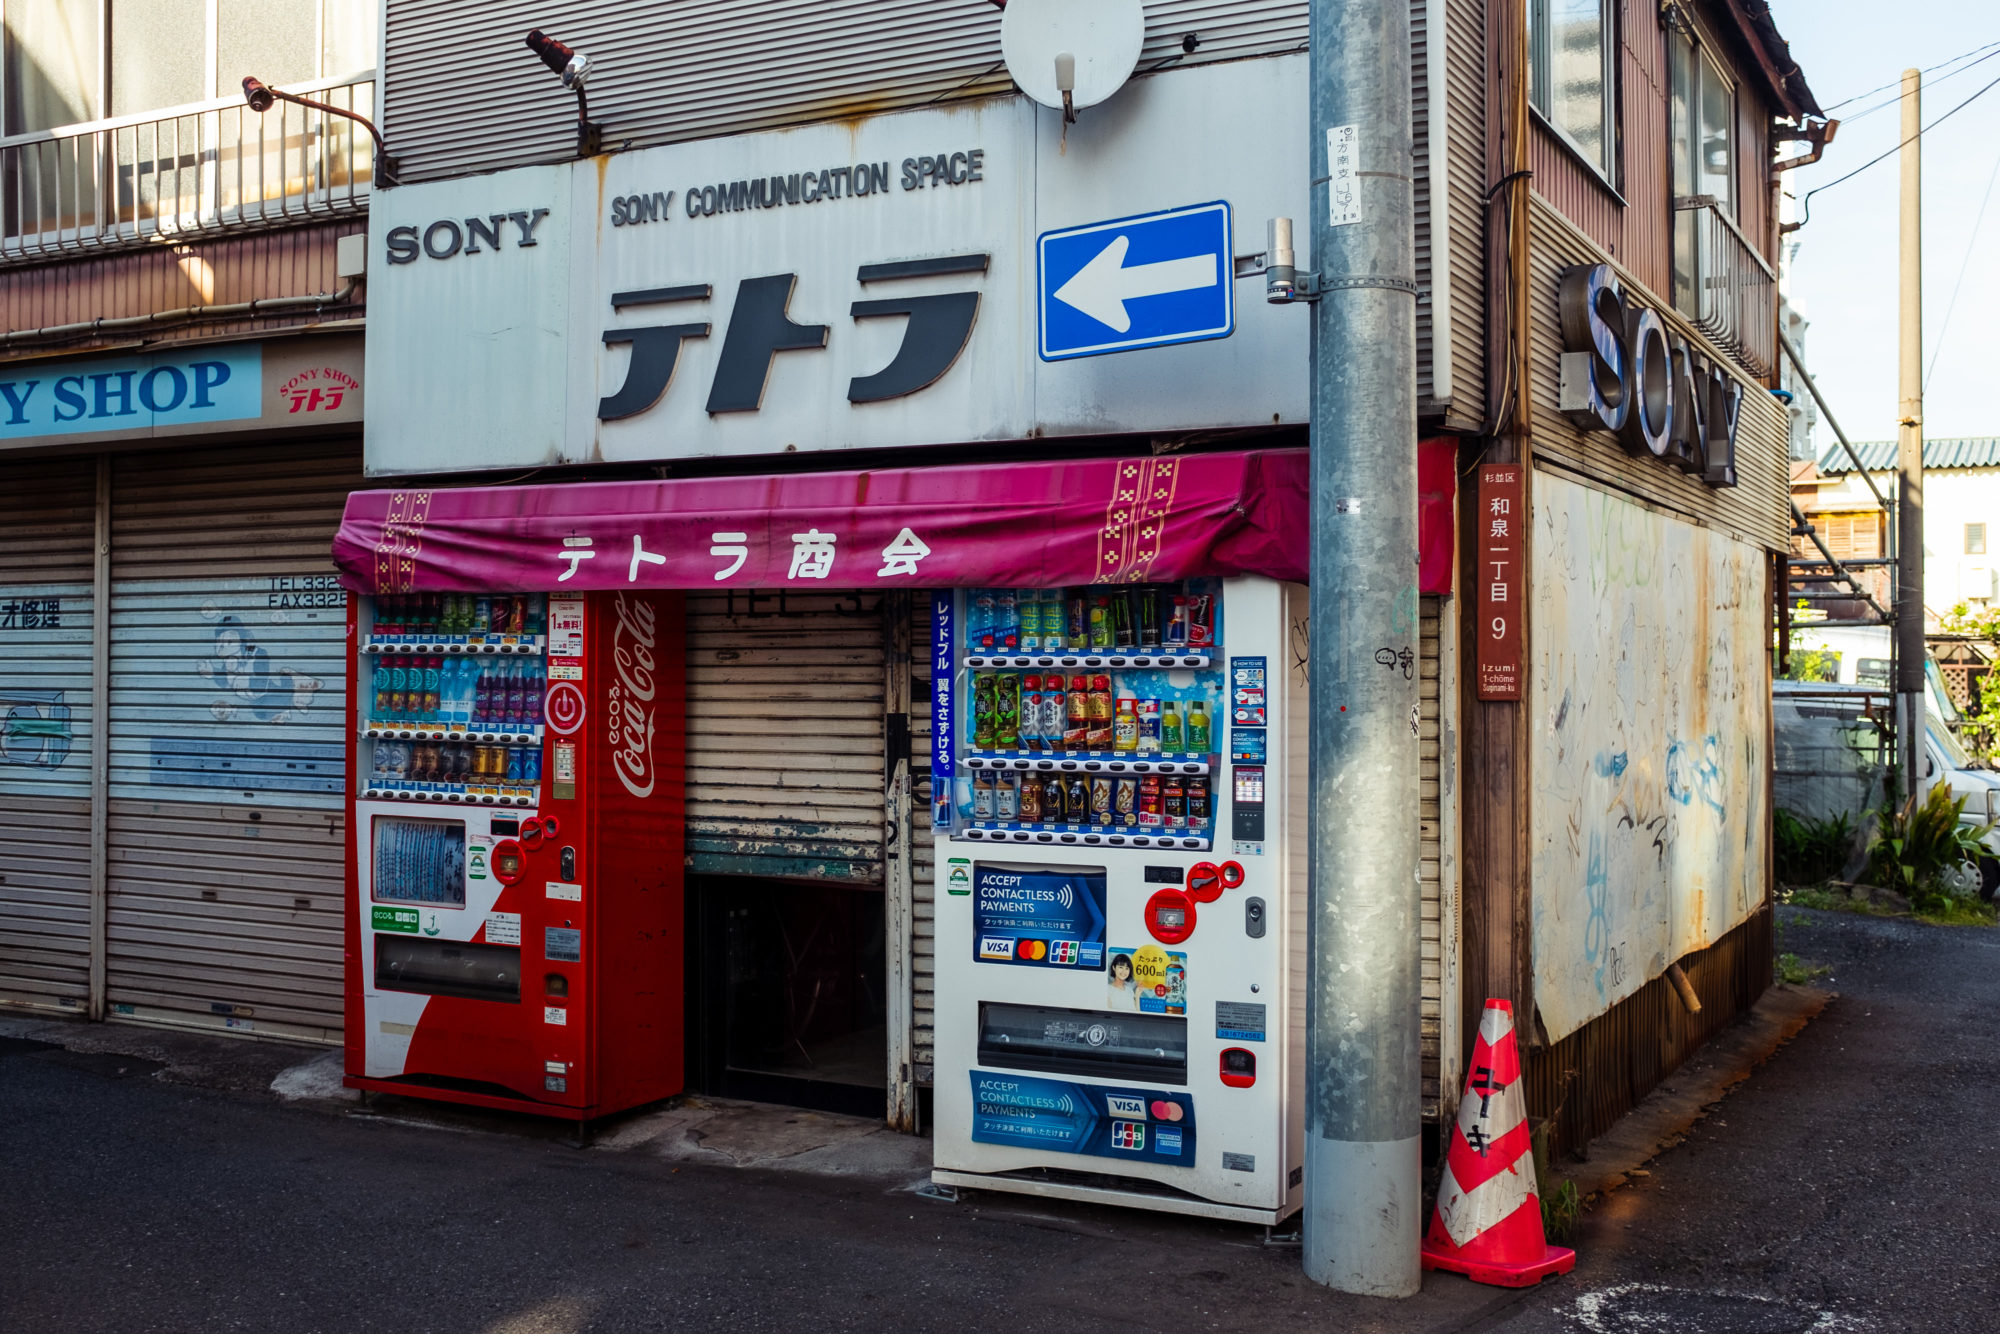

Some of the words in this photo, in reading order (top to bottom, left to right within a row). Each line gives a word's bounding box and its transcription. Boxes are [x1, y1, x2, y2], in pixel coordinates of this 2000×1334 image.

[611, 191, 675, 226] SONY
[686, 161, 889, 217] COMMUNICATION
[901, 149, 985, 191] SPACE
[386, 208, 550, 265] SONY
[598, 254, 991, 422] テトラ
[280, 368, 318, 398] SONY
[323, 367, 359, 392] SHOP
[1559, 263, 1744, 489] SONY
[53, 360, 231, 423] SHOP
[289, 386, 346, 414] テトラ
[1484, 472, 1516, 483] 杉並区
[557, 527, 932, 582] テトラ商会
[1489, 497, 1510, 602] 和泉一丁目
[937, 601, 950, 670] レッドブル
[1491, 617, 1506, 640] 9
[1482, 663, 1516, 672] Izumi
[1483, 673, 1515, 683] 1-chōme
[1482, 683, 1515, 693] Suginami-ku
[981, 875, 1022, 886] ACCEPT
[981, 888, 1055, 901] CONTACTLESS
[980, 901, 1035, 913] PAYMENTS
[986, 942, 1010, 953] VISA
[1050, 948, 1076, 957] JCB
[979, 1080, 1019, 1092] ACCEPT
[980, 1091, 1055, 1109] CONTACTLESS
[1113, 1100, 1142, 1113] VISA
[981, 1104, 1036, 1119] PAYMENTS
[1113, 1129, 1142, 1141] JCB
